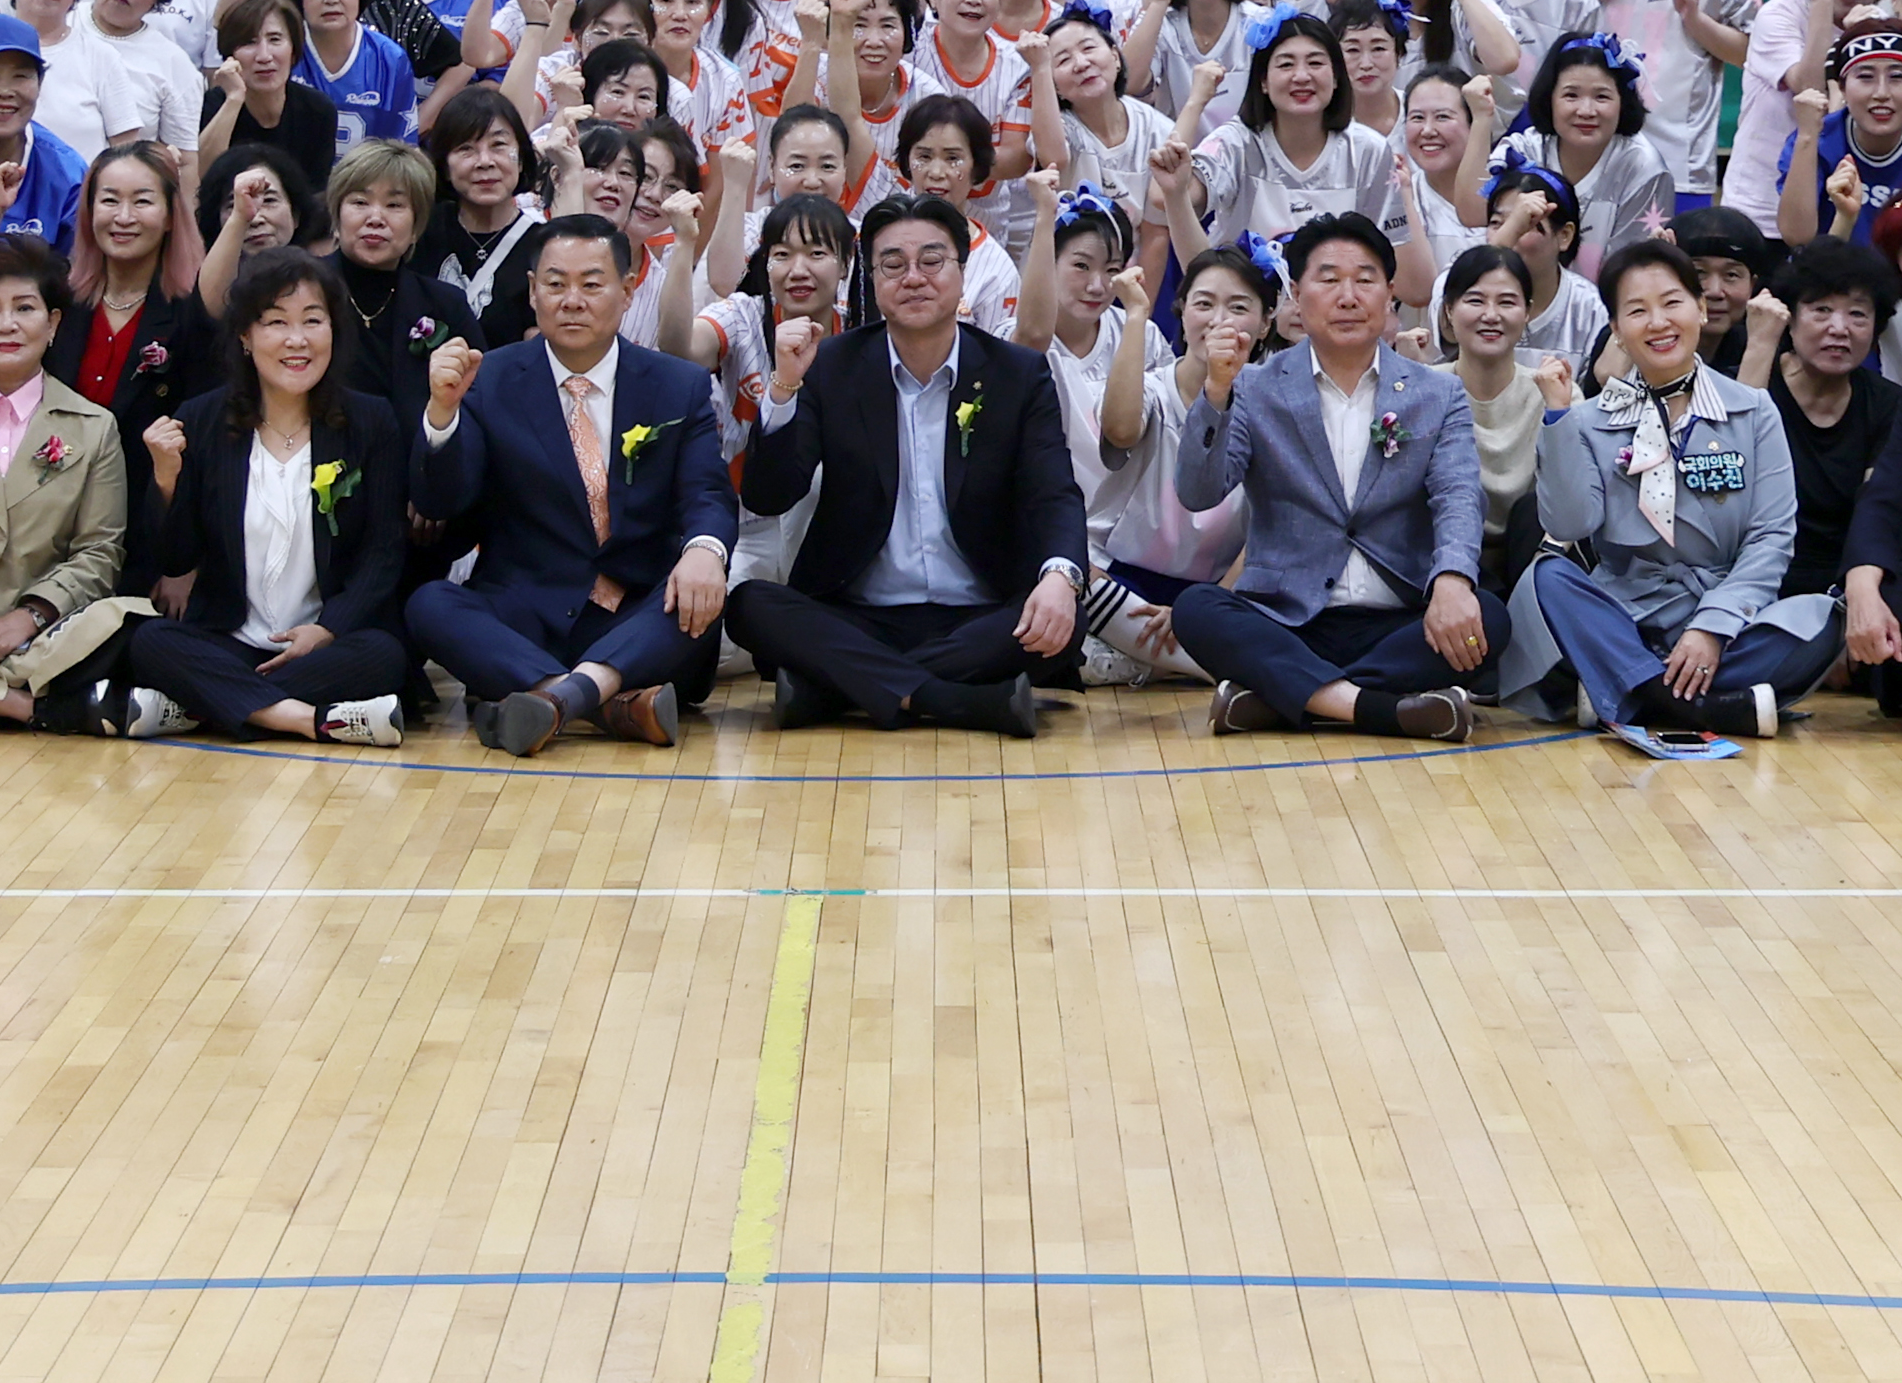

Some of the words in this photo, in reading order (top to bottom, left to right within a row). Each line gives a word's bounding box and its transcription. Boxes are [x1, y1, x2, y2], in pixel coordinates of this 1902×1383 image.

[1848, 36, 1898, 58] NY
[1684, 453, 1739, 473] 국회의원
[1686, 467, 1745, 492] 이수진
